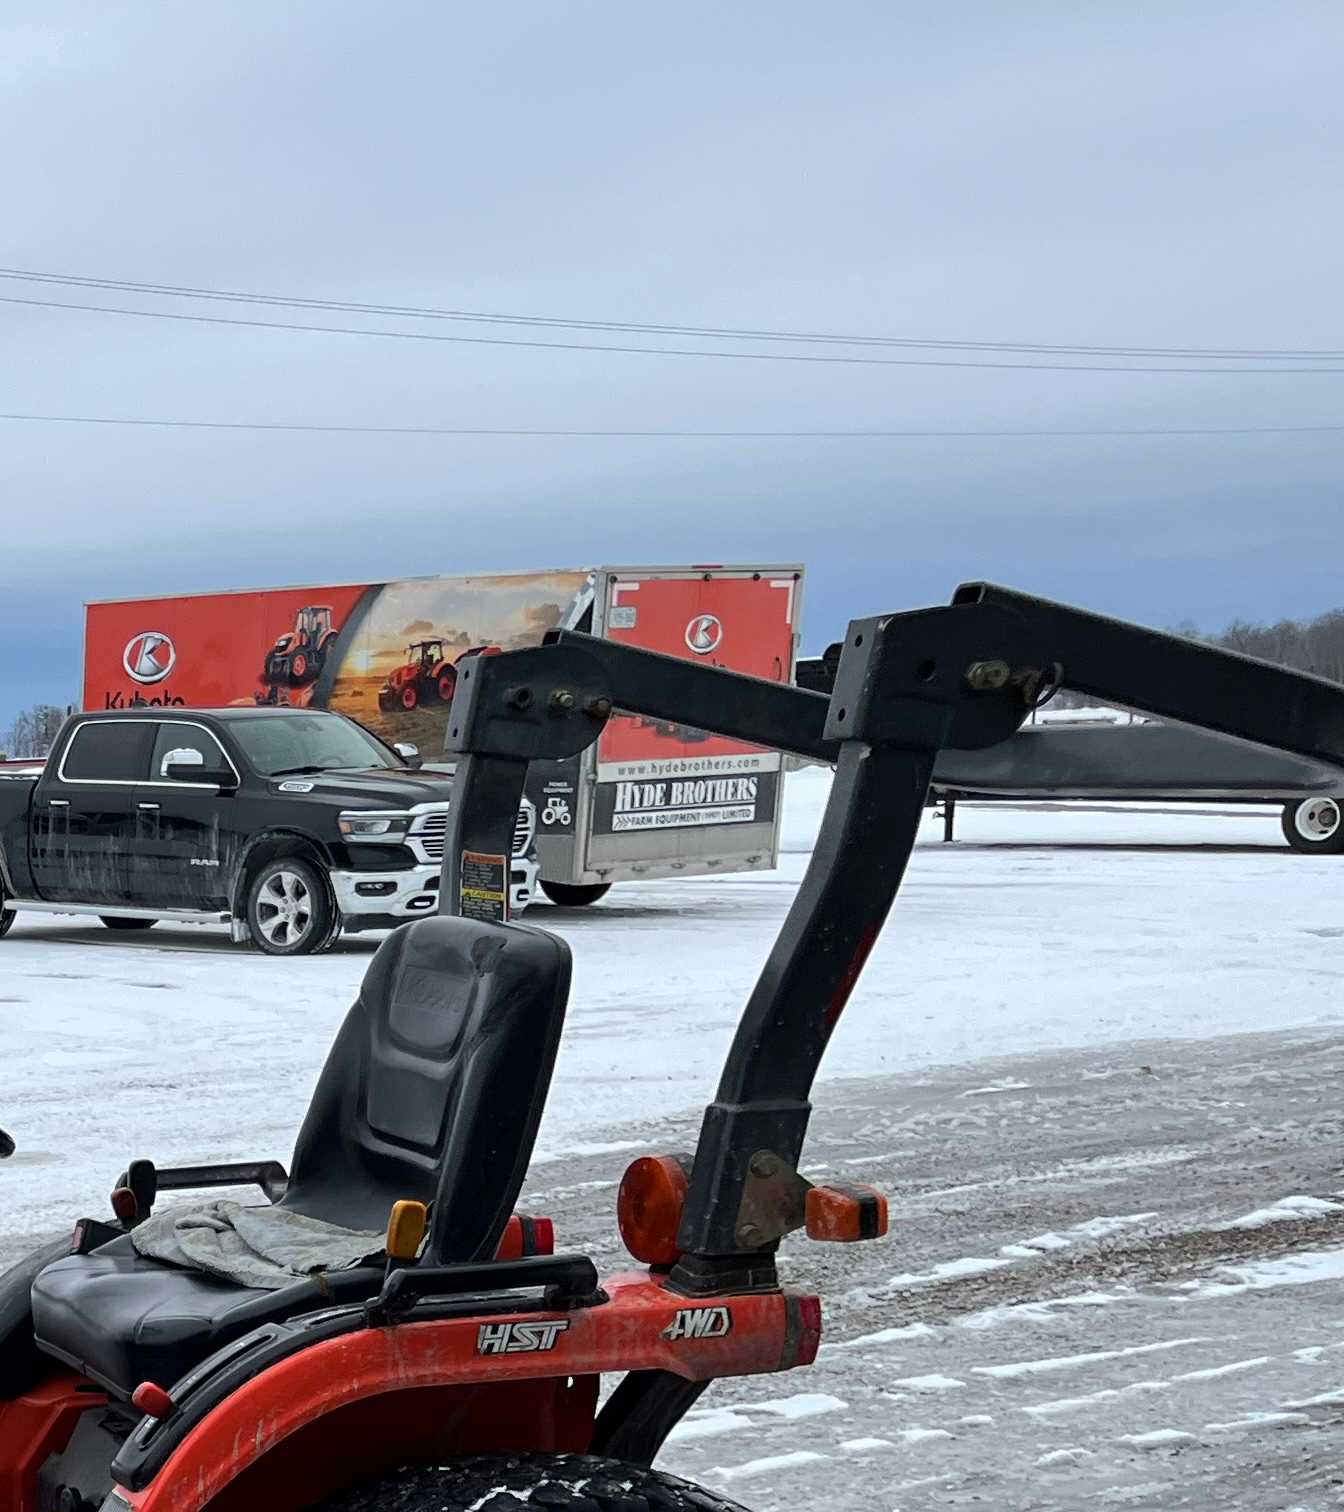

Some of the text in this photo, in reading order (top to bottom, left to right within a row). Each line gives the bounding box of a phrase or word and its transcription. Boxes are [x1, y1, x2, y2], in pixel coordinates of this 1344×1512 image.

[617, 758, 760, 776] www.hydebrothers.com
[614, 776, 758, 812] HYDE BROTHERS
[631, 815, 653, 826] FARM
[655, 812, 700, 825] EQUIPMENT
[190, 858, 220, 867] RAM
[658, 1306, 730, 1341] 4WD
